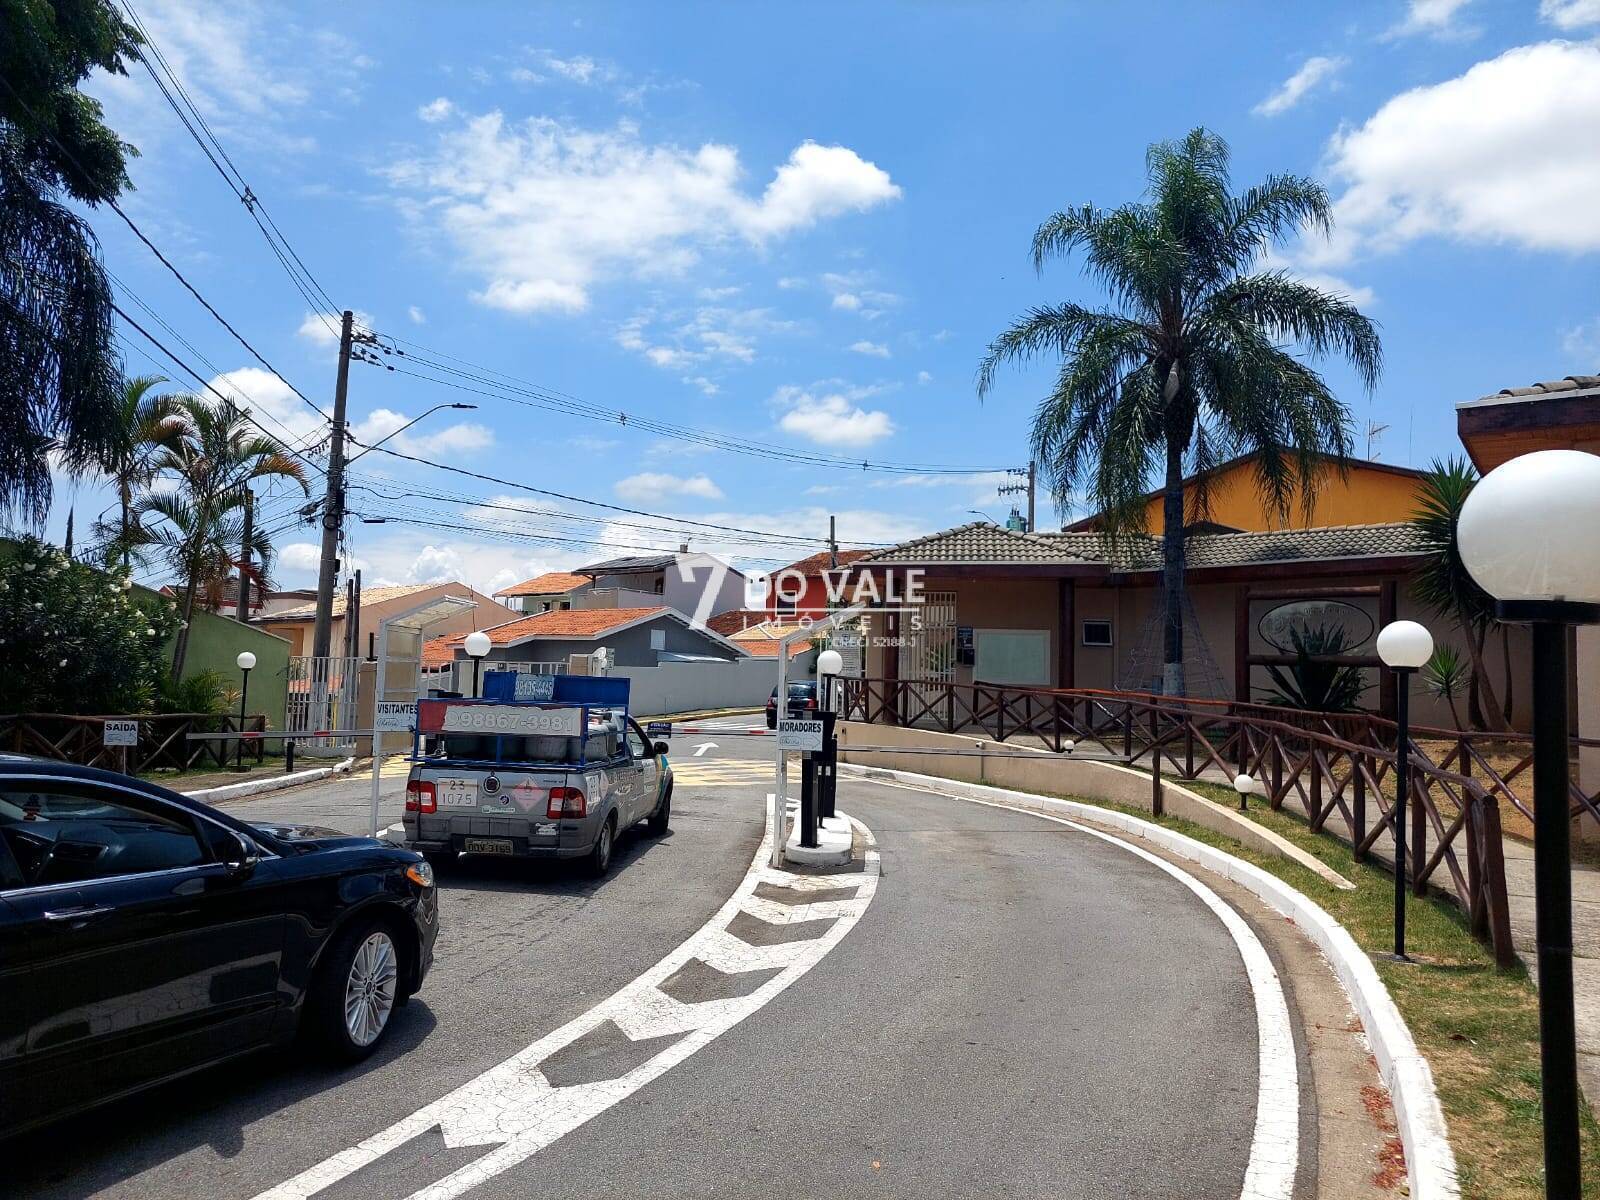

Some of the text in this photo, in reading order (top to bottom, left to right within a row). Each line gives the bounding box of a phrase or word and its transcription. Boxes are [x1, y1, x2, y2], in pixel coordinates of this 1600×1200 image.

[377, 703, 418, 715] VISITANTES
[779, 721, 822, 733] MORADORES
[449, 780, 465, 790] 23
[442, 793, 472, 805] 1075
